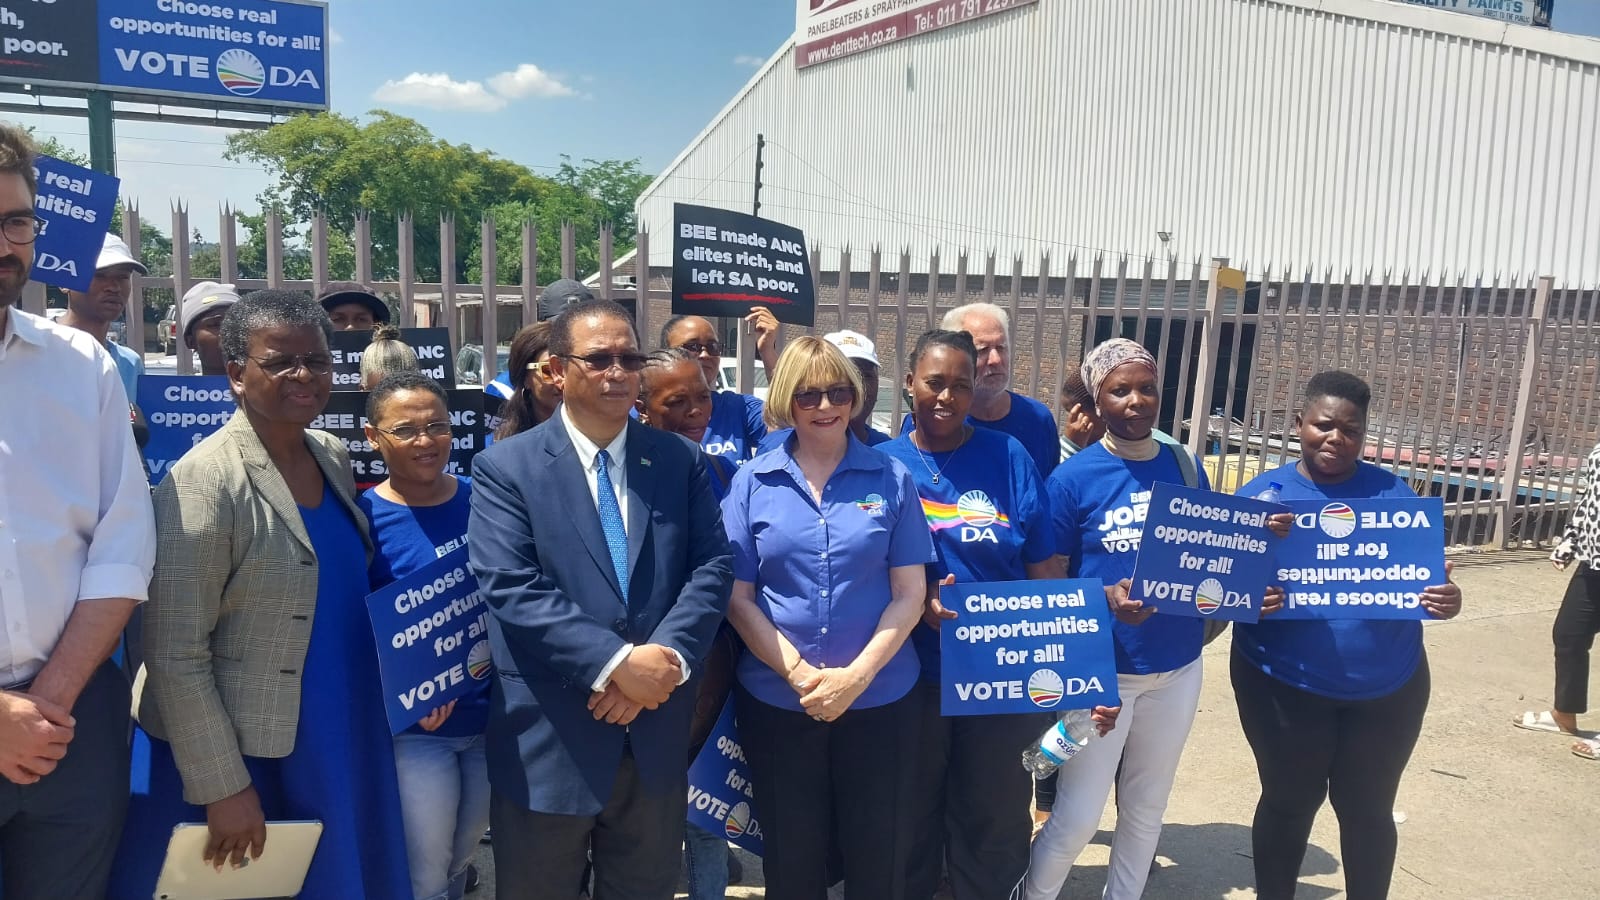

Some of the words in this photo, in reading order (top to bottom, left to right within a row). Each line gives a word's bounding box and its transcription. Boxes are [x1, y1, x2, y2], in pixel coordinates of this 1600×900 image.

[157, 0, 234, 20] Choose
[239, 8, 277, 25] real
[808, 10, 862, 38] PANELBEATERS
[864, 8, 870, 20] &
[914, 11, 934, 32] Tel:
[937, 3, 956, 26] 011
[960, 0, 981, 19] 791
[110, 16, 253, 43] opportunities
[257, 31, 287, 47] for
[291, 35, 321, 50] all!
[808, 26, 897, 64] www.denttech.co.za
[4, 37, 68, 56] poor.
[114, 48, 210, 78] VOTE
[269, 66, 320, 89] DA
[45, 171, 93, 196] real
[35, 193, 97, 223] nities
[680, 223, 717, 241] BEE
[721, 229, 767, 248] made
[770, 237, 803, 257] ANC
[36, 252, 78, 277] DA
[682, 246, 732, 264] elites
[736, 252, 772, 271] rich,
[776, 259, 804, 275] and
[692, 269, 724, 285] left
[728, 271, 754, 288] SA
[757, 276, 799, 294] poor.
[332, 372, 361, 385] tes
[421, 365, 445, 379] nd
[164, 386, 233, 401] Choos
[151, 411, 233, 427] opport
[449, 411, 477, 426] NC
[345, 437, 373, 452] tes
[451, 434, 474, 450] nd
[706, 441, 738, 456] DA
[1098, 502, 1149, 531] JOB
[1169, 497, 1231, 523] Choose
[1232, 509, 1268, 528] real
[1294, 512, 1316, 529] D
[1361, 511, 1431, 529] VOTE
[961, 526, 999, 544] DA
[1101, 538, 1141, 554] VOT
[1154, 524, 1268, 554] opportunities
[1179, 551, 1205, 571] for
[1206, 556, 1234, 575] all!
[1316, 542, 1350, 560] all!
[1354, 542, 1389, 560] for
[1277, 564, 1431, 584] opportunities
[394, 566, 466, 614] Choose
[965, 594, 1043, 613] Choose
[1047, 589, 1086, 609] real
[1142, 579, 1197, 602] VOTE
[1223, 591, 1252, 609] DA
[1289, 592, 1331, 609] real
[1335, 592, 1420, 609] Choose
[391, 588, 484, 649] opportun
[955, 615, 1099, 644] opportunities
[434, 629, 465, 657] for
[996, 647, 1029, 666] for
[1033, 644, 1065, 664] all!
[398, 662, 465, 711] VOTE
[955, 680, 1024, 701] VOTE
[1066, 676, 1105, 696] DA
[725, 768, 746, 791] for
[688, 784, 731, 821] VOTE
